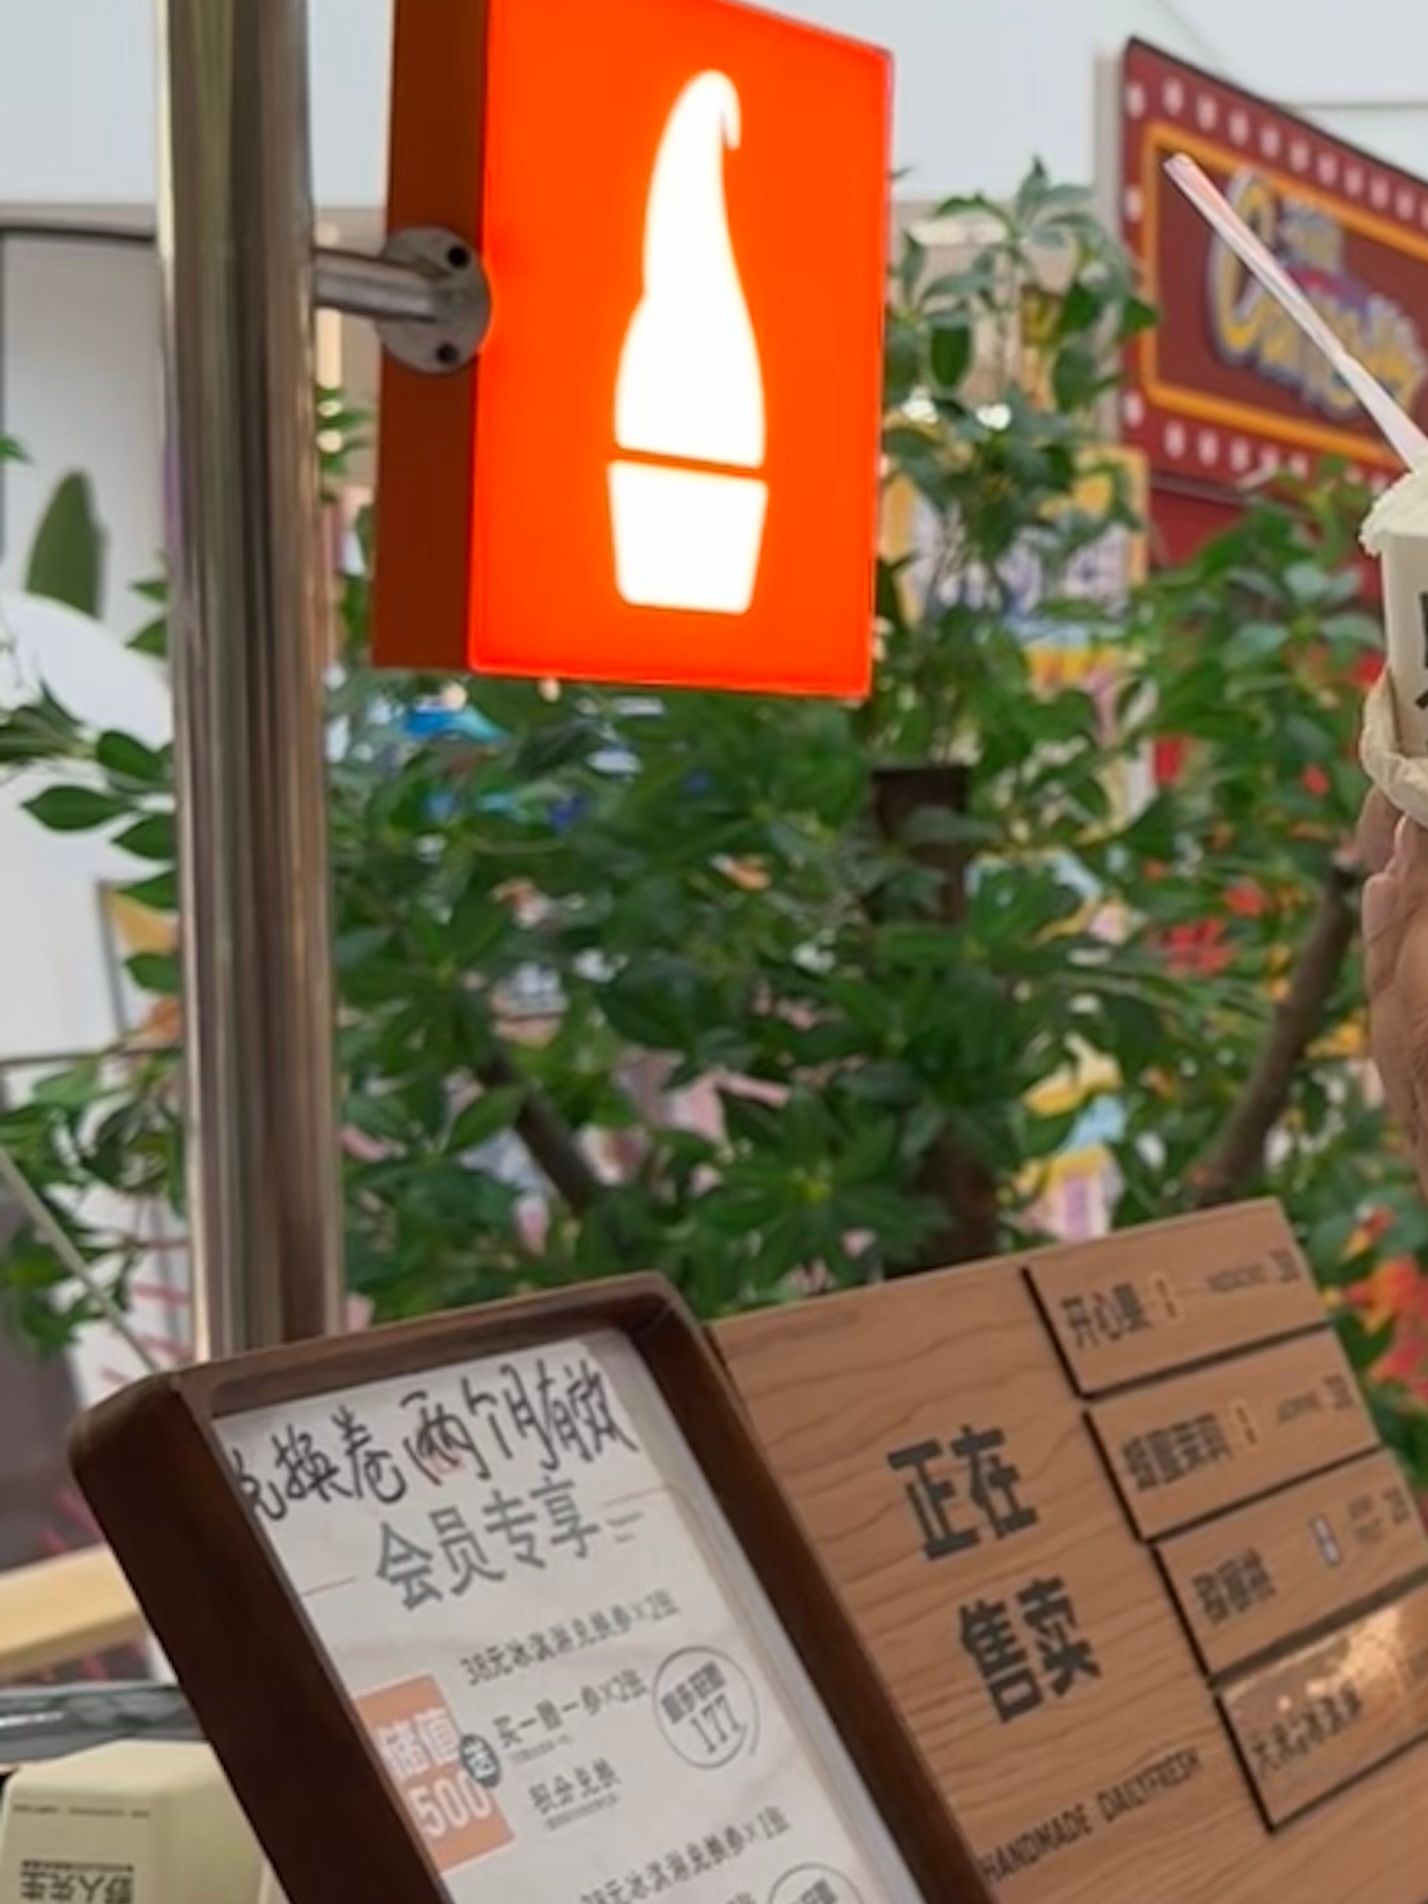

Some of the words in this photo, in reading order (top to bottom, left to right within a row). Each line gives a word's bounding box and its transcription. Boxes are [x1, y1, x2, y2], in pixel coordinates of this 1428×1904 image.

[376, 1474, 600, 1610] 会员专享
[886, 1424, 1040, 1561] 正在
[958, 1575, 1101, 1724] 售卖
[691, 1694, 741, 1755] 177
[411, 1771, 491, 1837] 500
